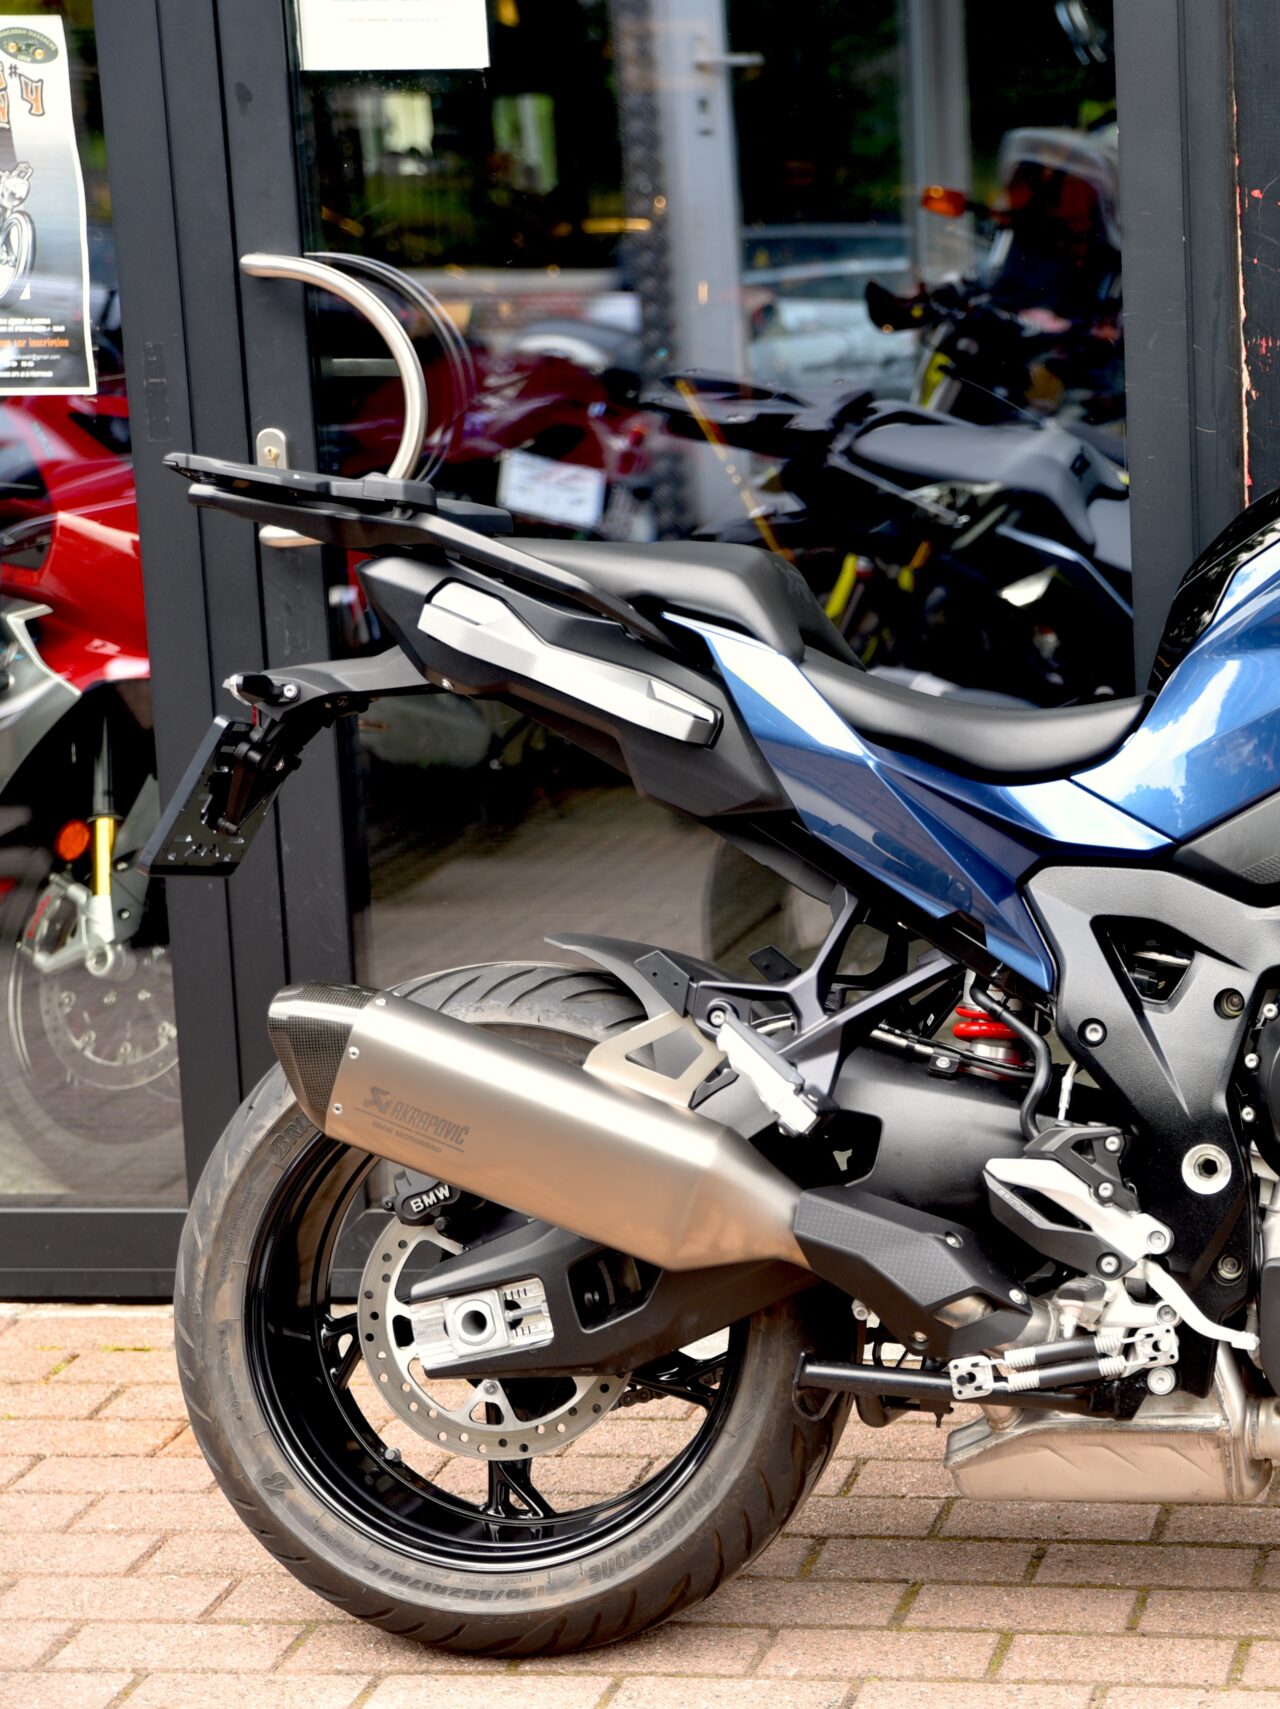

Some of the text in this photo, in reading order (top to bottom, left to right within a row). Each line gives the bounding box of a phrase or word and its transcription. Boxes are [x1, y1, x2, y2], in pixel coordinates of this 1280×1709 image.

[371, 1120, 442, 1153] BMW MOTORRAD
[410, 1184, 450, 1213] BMW
[586, 1472, 719, 1584] BRIDGESTONE
